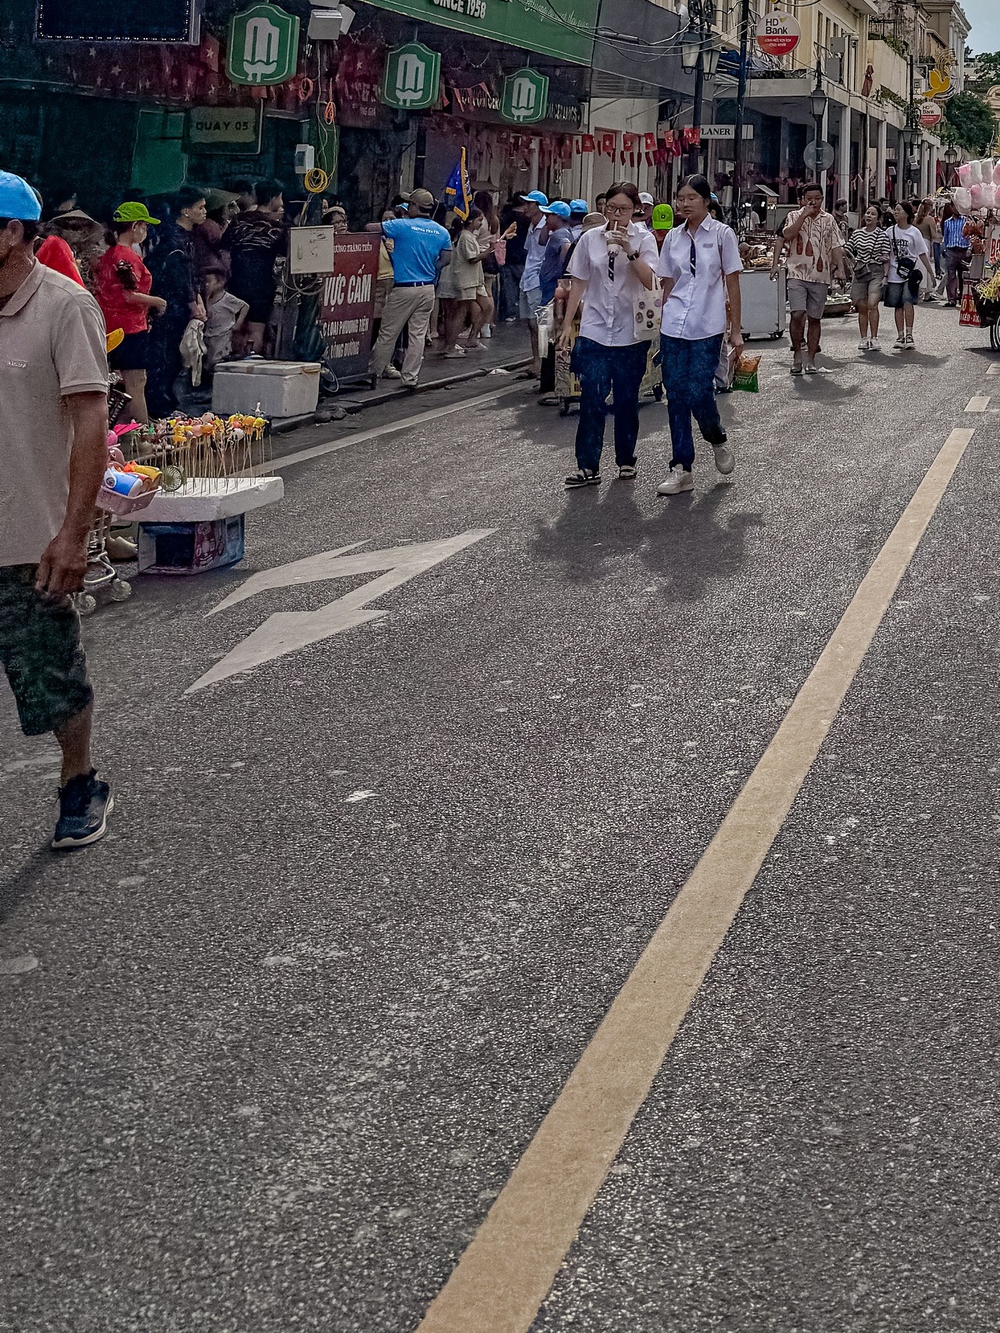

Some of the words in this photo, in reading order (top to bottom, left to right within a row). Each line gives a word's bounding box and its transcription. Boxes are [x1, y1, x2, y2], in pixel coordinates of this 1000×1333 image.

[765, 18, 779, 26] HD
[235, 121, 249, 131] 05
[701, 127, 731, 136] LANER
[323, 273, 346, 312] VỰC
[347, 264, 372, 304] CẤM
